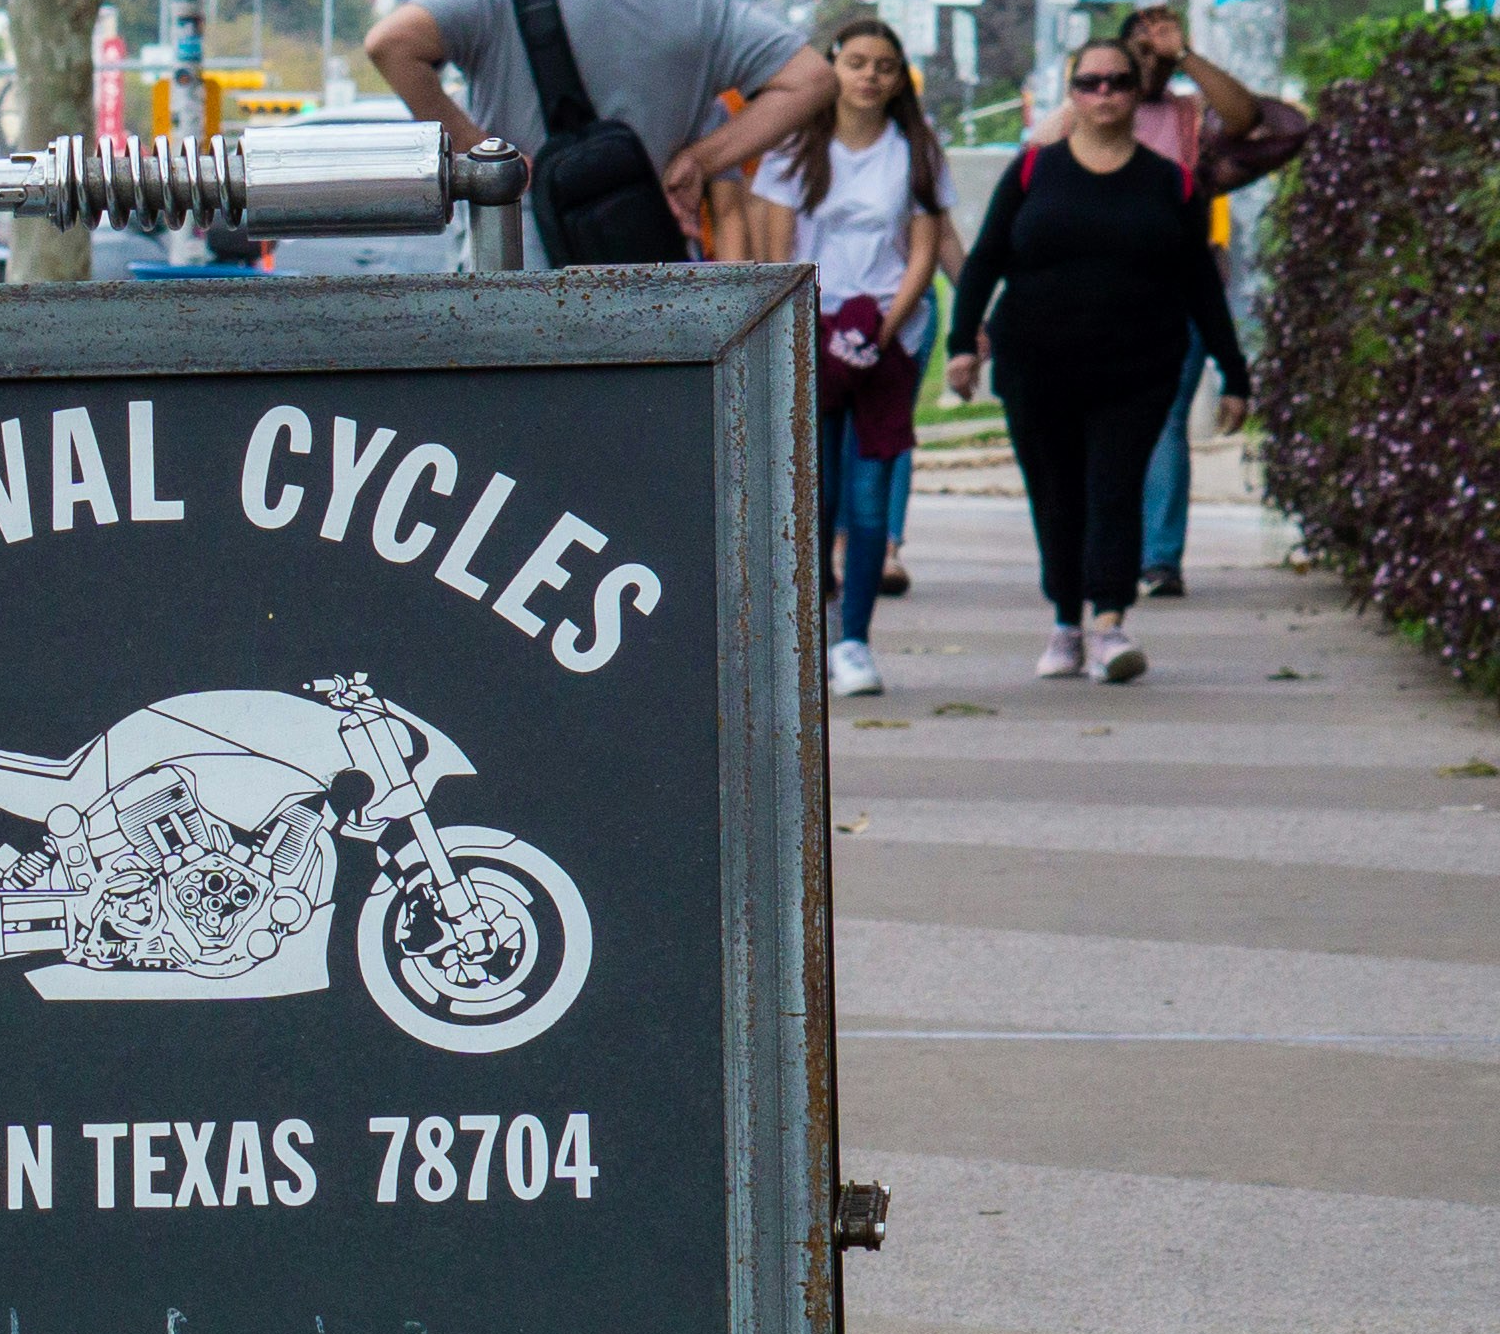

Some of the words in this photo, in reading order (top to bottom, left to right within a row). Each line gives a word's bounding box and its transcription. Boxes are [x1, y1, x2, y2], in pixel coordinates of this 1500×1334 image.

[240, 403, 663, 674] CYCLES
[83, 1117, 318, 1210] TEXAS
[369, 1112, 600, 1204] 78704
